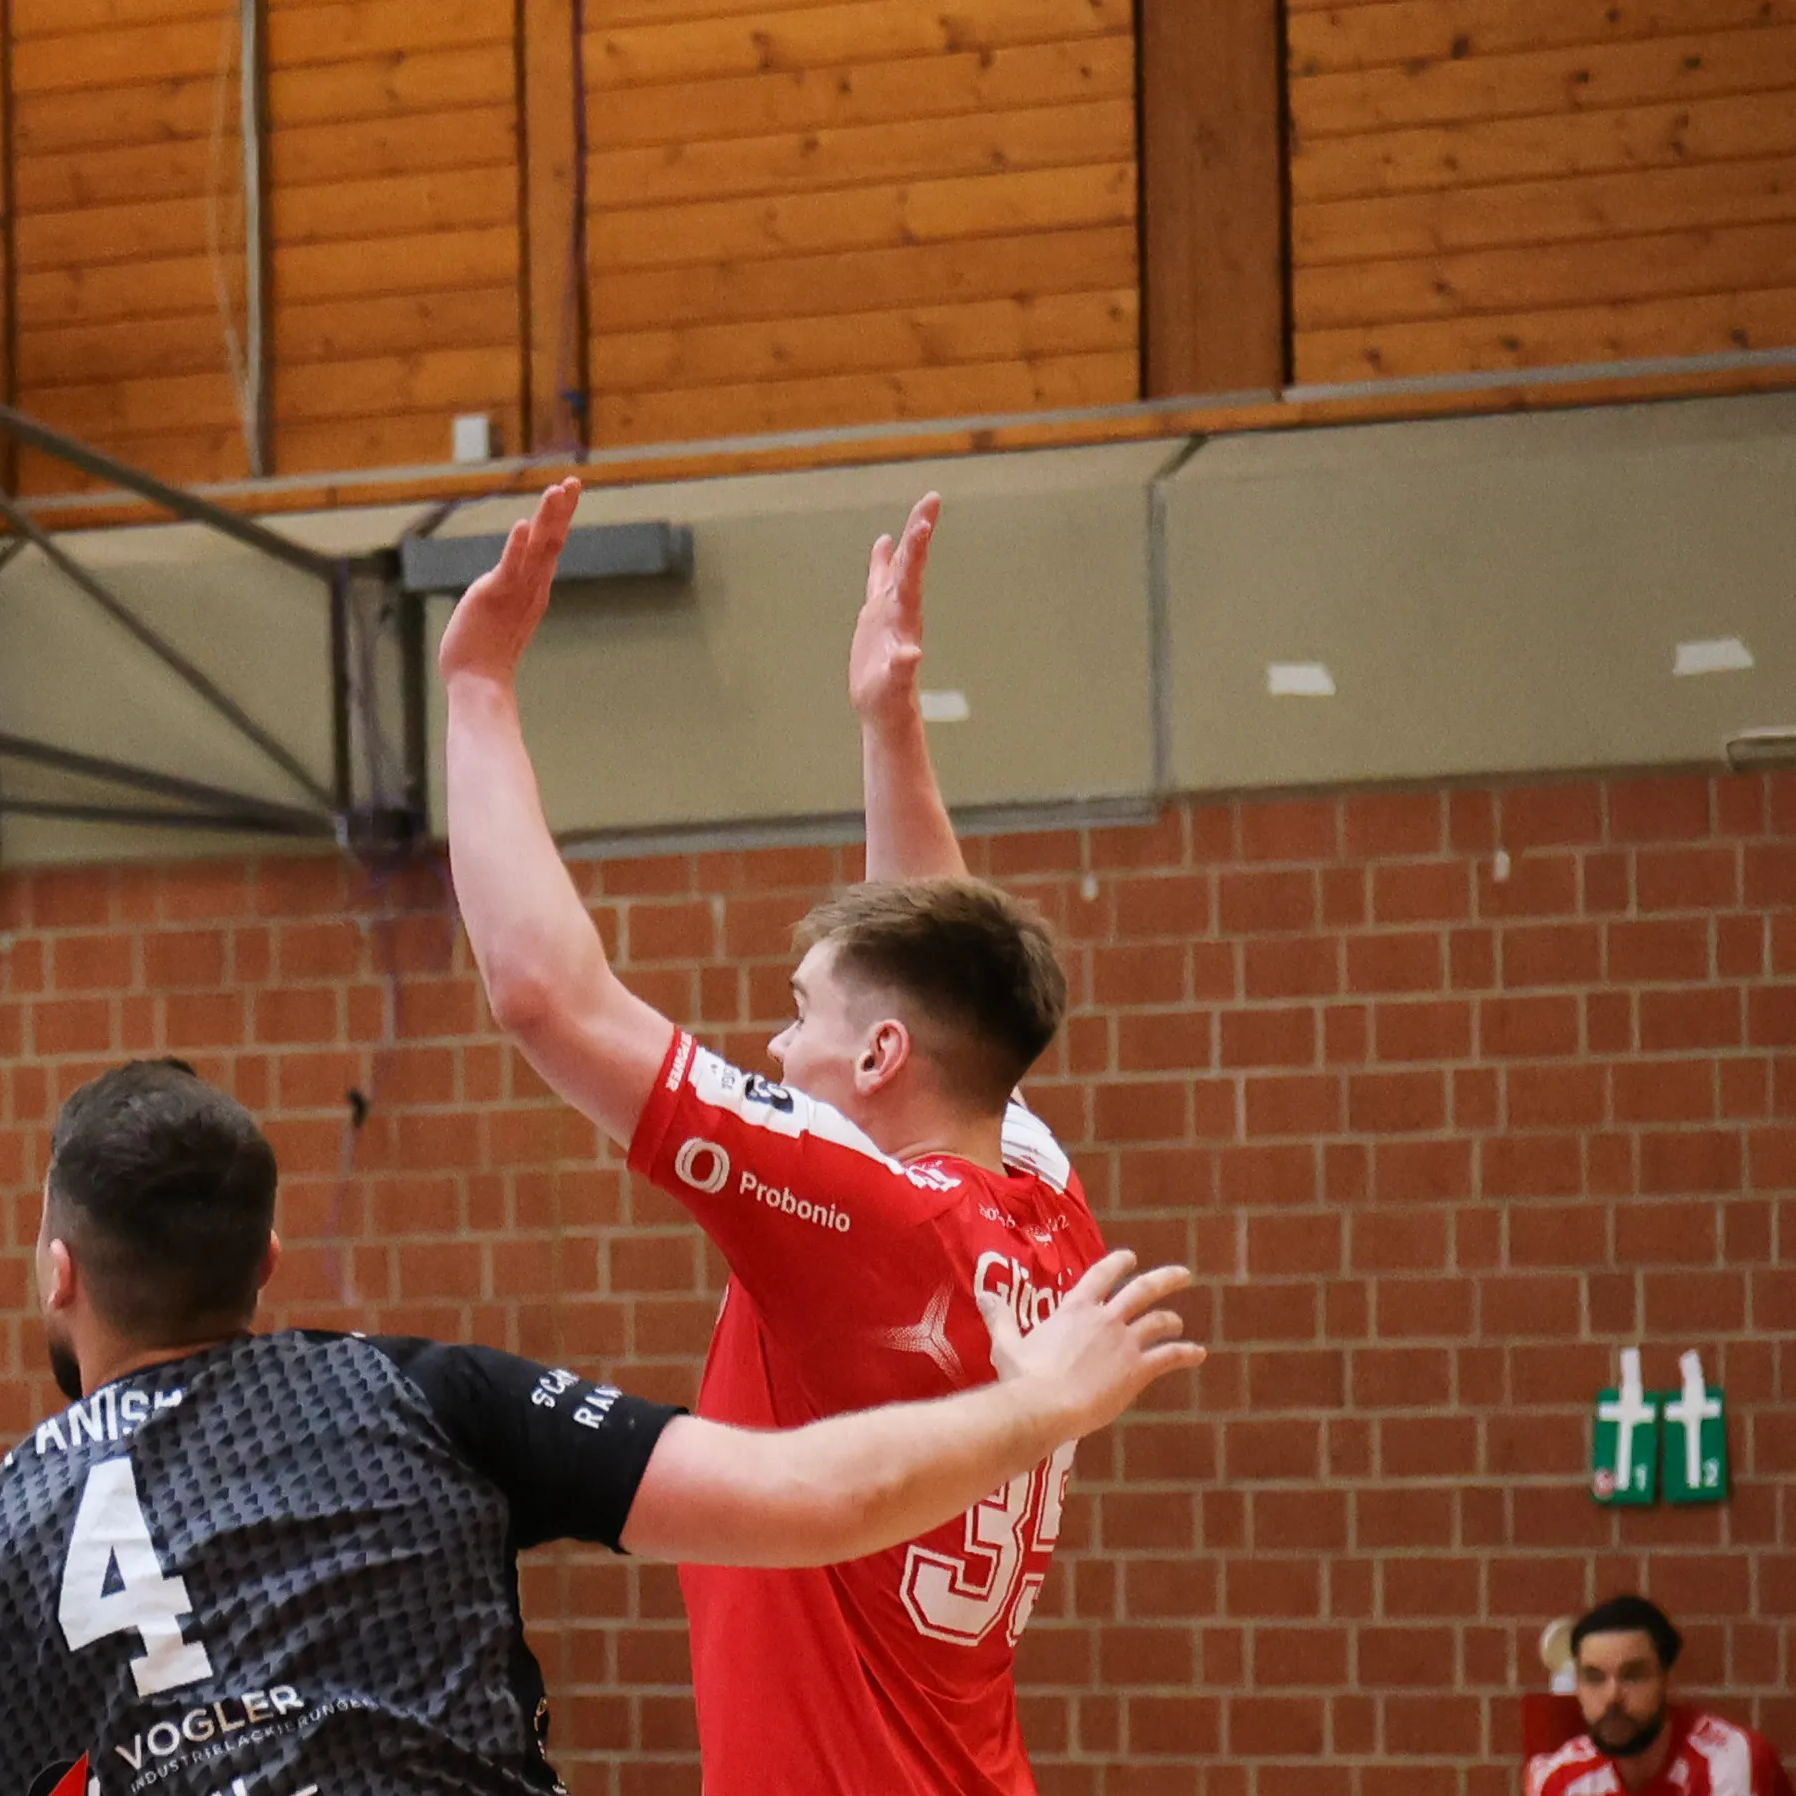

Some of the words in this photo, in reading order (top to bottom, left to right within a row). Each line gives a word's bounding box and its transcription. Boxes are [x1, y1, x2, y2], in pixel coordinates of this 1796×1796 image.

[739, 1171, 851, 1233] Probonio
[58, 1456, 213, 1698] 4
[115, 1684, 305, 1771] VOGLER
